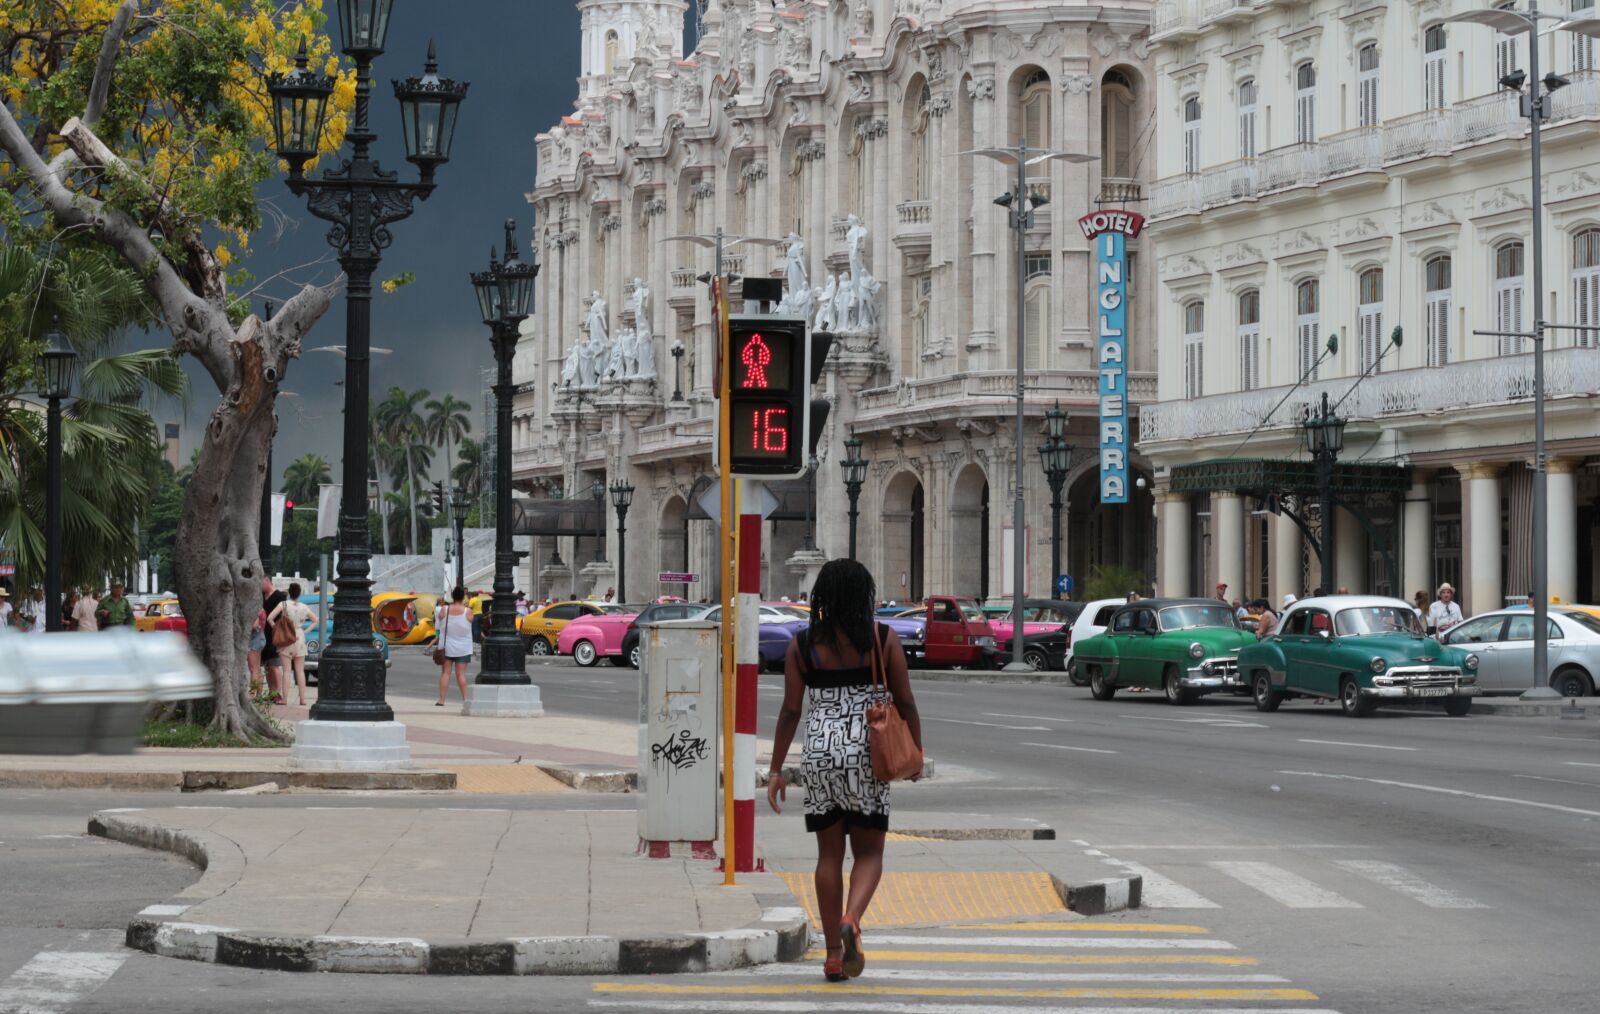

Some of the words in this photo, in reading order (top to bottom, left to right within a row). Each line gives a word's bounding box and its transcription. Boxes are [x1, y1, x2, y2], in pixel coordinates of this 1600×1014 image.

[1081, 212, 1135, 237] HOTEL
[1099, 235, 1124, 498] INGLATERRA
[753, 409, 787, 451] 16
